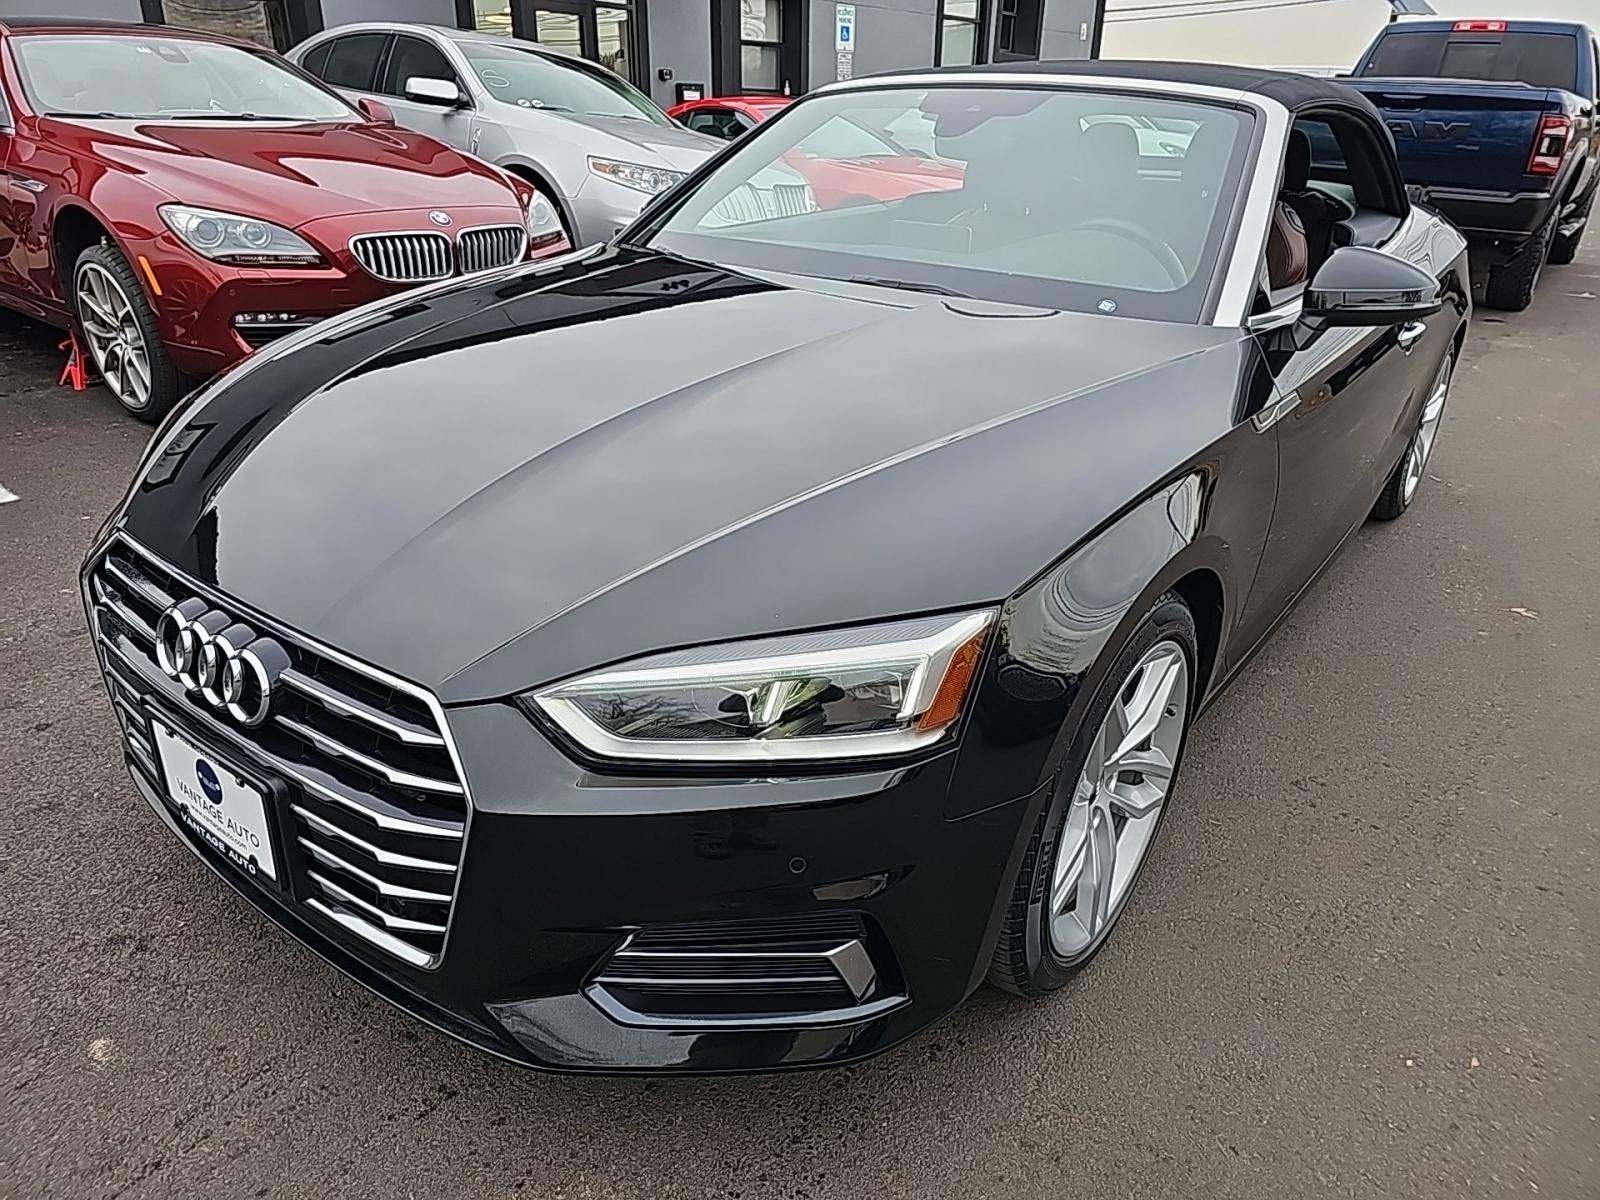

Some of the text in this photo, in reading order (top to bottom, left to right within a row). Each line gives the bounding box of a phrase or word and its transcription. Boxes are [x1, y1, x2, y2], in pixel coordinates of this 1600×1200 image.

[1384, 119, 1472, 141] AM
[175, 776, 224, 825] VANTAGE
[227, 818, 260, 848] AUTO
[180, 810, 257, 875] VANTAGE AUTO
